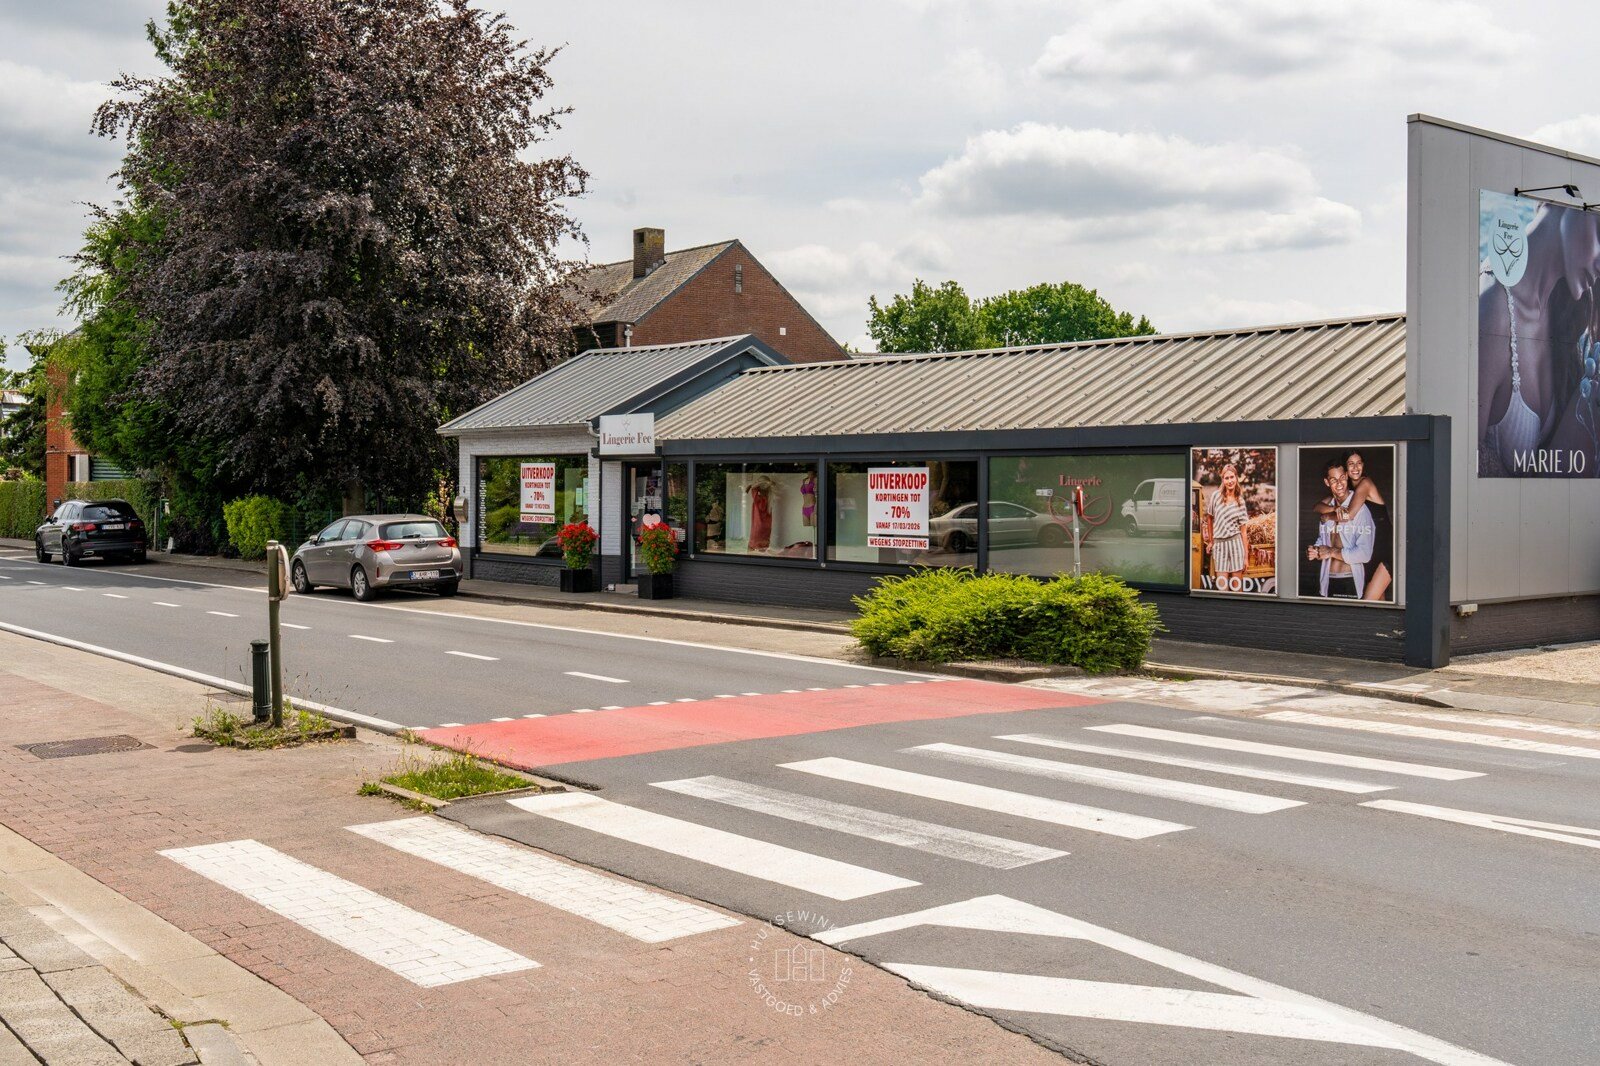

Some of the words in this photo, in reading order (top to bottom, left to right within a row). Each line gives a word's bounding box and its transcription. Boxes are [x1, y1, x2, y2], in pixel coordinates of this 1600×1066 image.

[1498, 219, 1519, 230] Lingerie
[1503, 231, 1513, 240] Fee
[602, 432, 636, 447] Lingerie
[637, 432, 652, 444] Fee
[1513, 449, 1563, 473] MARIE
[1567, 449, 1586, 474] JO
[521, 467, 554, 479] UITVERKOOP
[869, 473, 927, 490] UITVERKOOP
[1058, 474, 1102, 487] Lingerie
[875, 493, 909, 502] KORTINGEN
[911, 493, 921, 502] TOT
[891, 506, 911, 519] 70%
[875, 521, 891, 529] VANAF
[892, 522, 921, 530] 17/03/2026
[1320, 525, 1371, 534] IMPETUS
[869, 538, 892, 547] WEGENS
[892, 538, 927, 548] STOPZETTING
[1200, 574, 1265, 593] WOODY
